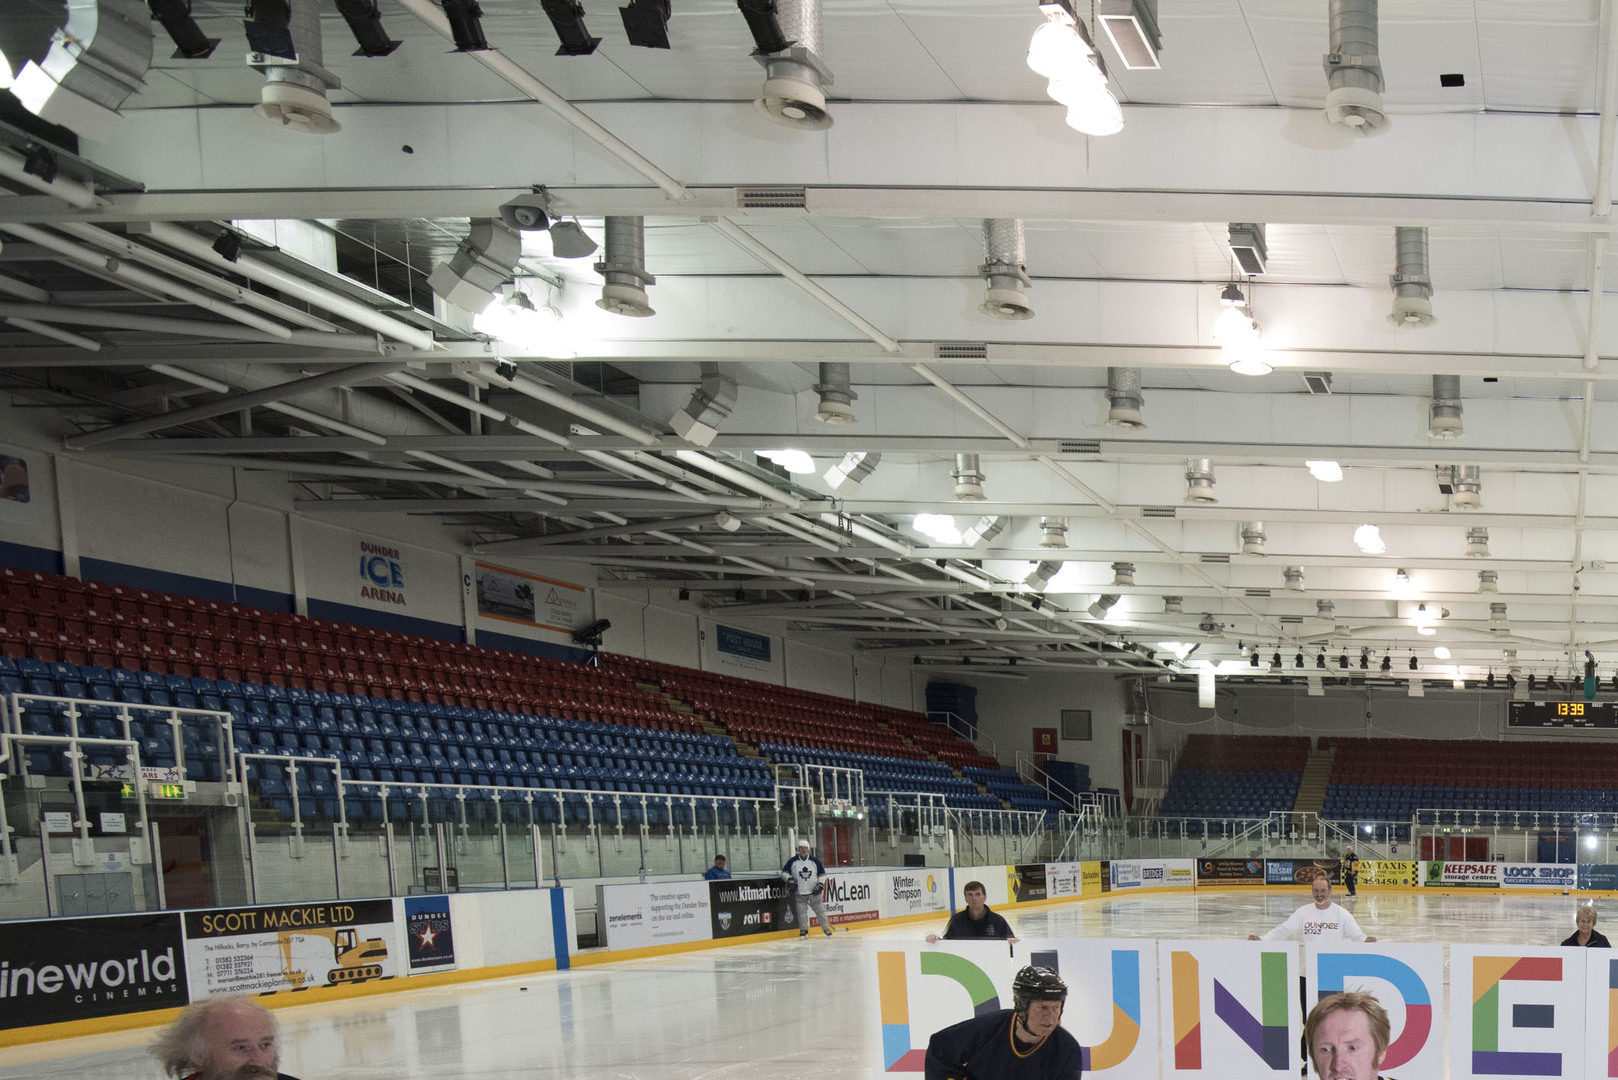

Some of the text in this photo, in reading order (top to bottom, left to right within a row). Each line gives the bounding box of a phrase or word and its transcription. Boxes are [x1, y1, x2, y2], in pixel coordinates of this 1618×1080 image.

[360, 541, 400, 559] DUNDEE
[360, 555, 404, 590] ICE
[360, 586, 406, 607] ARENA
[1558, 703, 1584, 715] 13:39
[1143, 868, 1163, 879] BRIDGE
[1444, 864, 1497, 874] KEEPSAFE
[1503, 867, 1538, 877] LOCK
[1539, 867, 1575, 878] SHOP
[893, 876, 914, 888] Winter
[1444, 874, 1470, 882] storage
[719, 885, 790, 903] www.kitmart.co.uk
[823, 877, 871, 903] McLean
[893, 888, 922, 901] Simpson
[659, 893, 676, 901] creative
[650, 903, 673, 912] supporting
[826, 903, 844, 913] Roofing
[909, 900, 922, 911] print
[202, 905, 355, 933] SCOTT MACKIE LTD
[411, 912, 447, 921] DUNDEE
[609, 913, 643, 922] zenelements
[1304, 922, 1339, 930] DUNDEE
[216, 963, 233, 971] 01382
[75, 984, 178, 1004] CINEMAS
